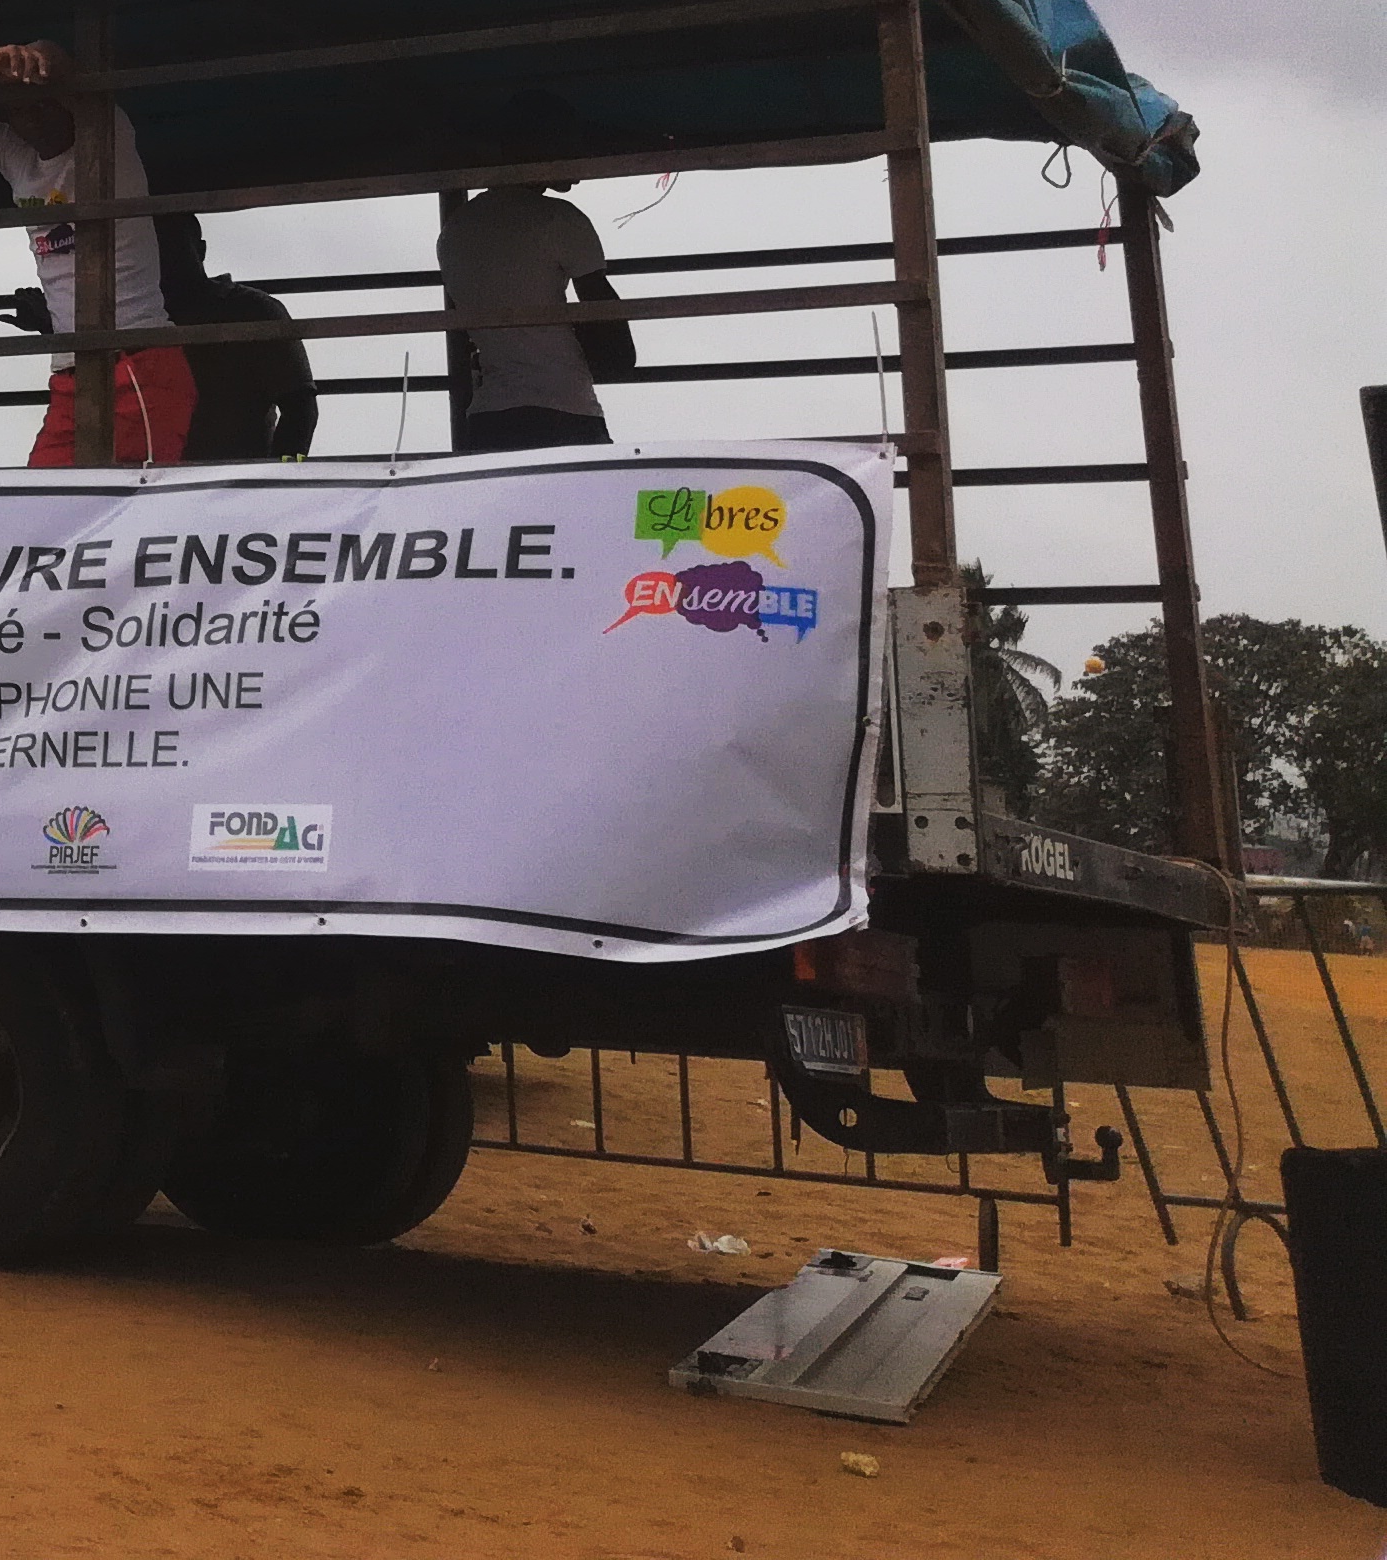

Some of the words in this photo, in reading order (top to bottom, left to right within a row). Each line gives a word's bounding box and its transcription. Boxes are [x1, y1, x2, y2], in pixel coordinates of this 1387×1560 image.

[648, 487, 779, 532] Libres
[134, 525, 575, 588] ENSEMBLE.
[81, 599, 320, 652] Solidarité
[168, 672, 264, 710] UNE
[49, 845, 100, 864] PIRJEF
